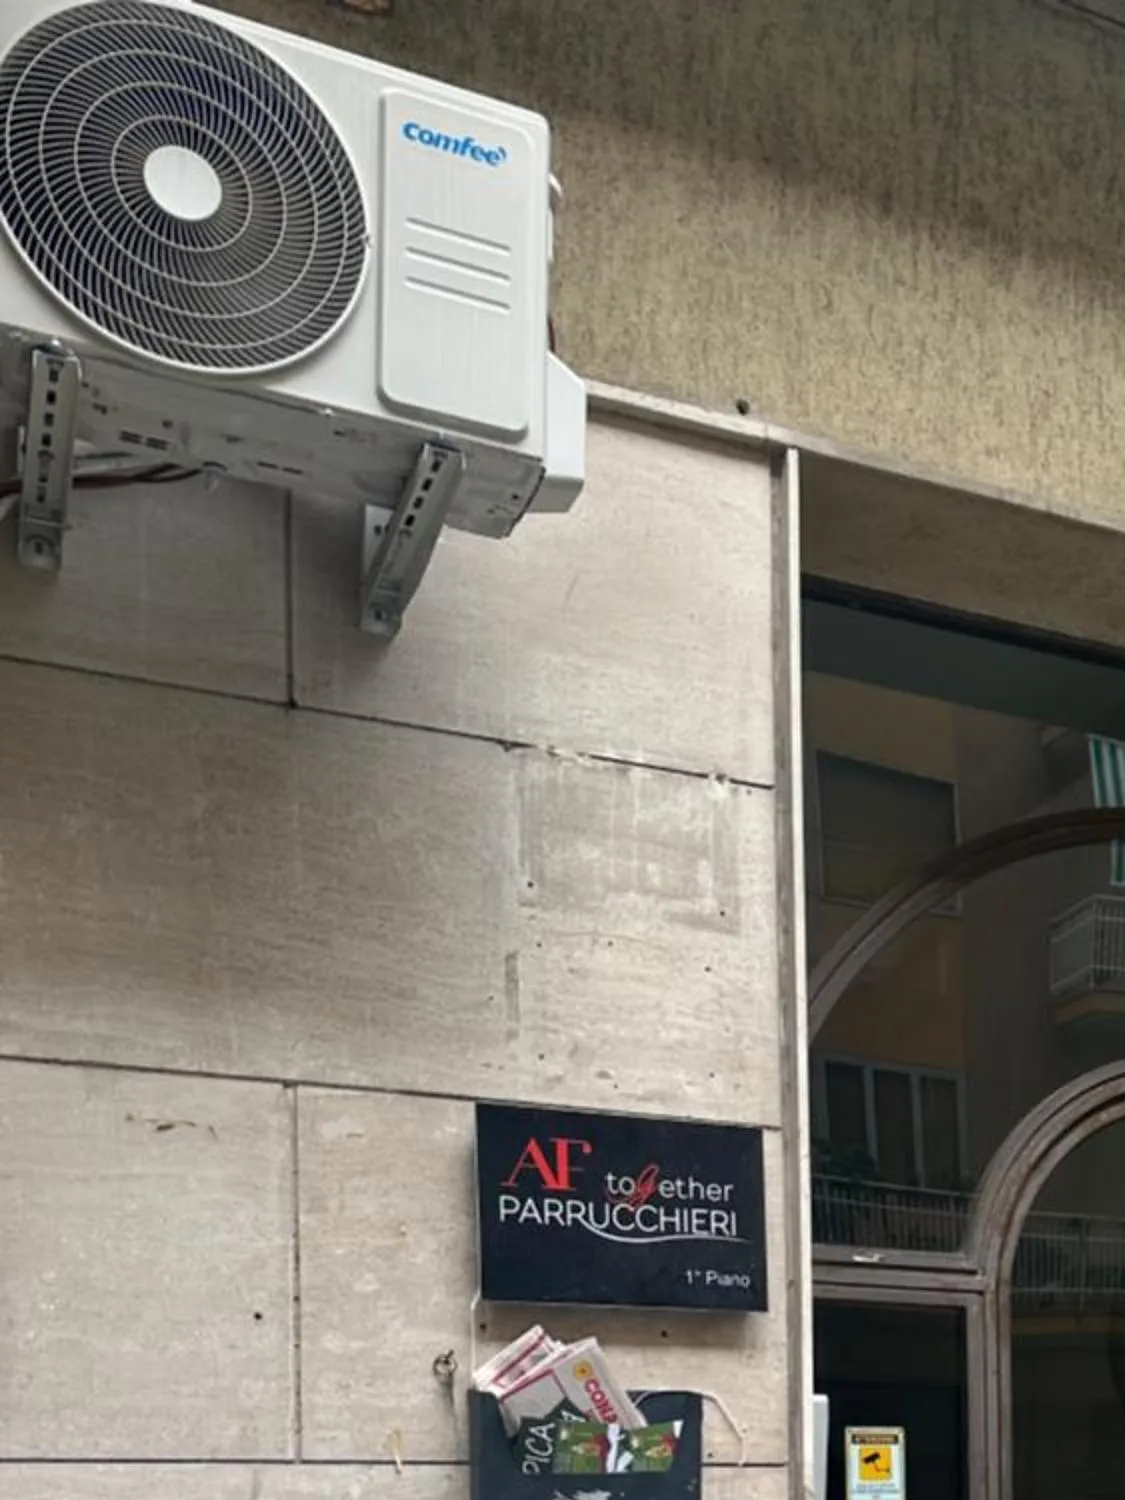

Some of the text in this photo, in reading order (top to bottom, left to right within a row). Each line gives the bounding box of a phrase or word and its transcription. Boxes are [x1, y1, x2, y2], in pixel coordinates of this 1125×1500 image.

[500, 1136, 592, 1191] AF
[499, 1195, 737, 1237] PARRUCCHIERI
[705, 1270, 751, 1288] Piano
